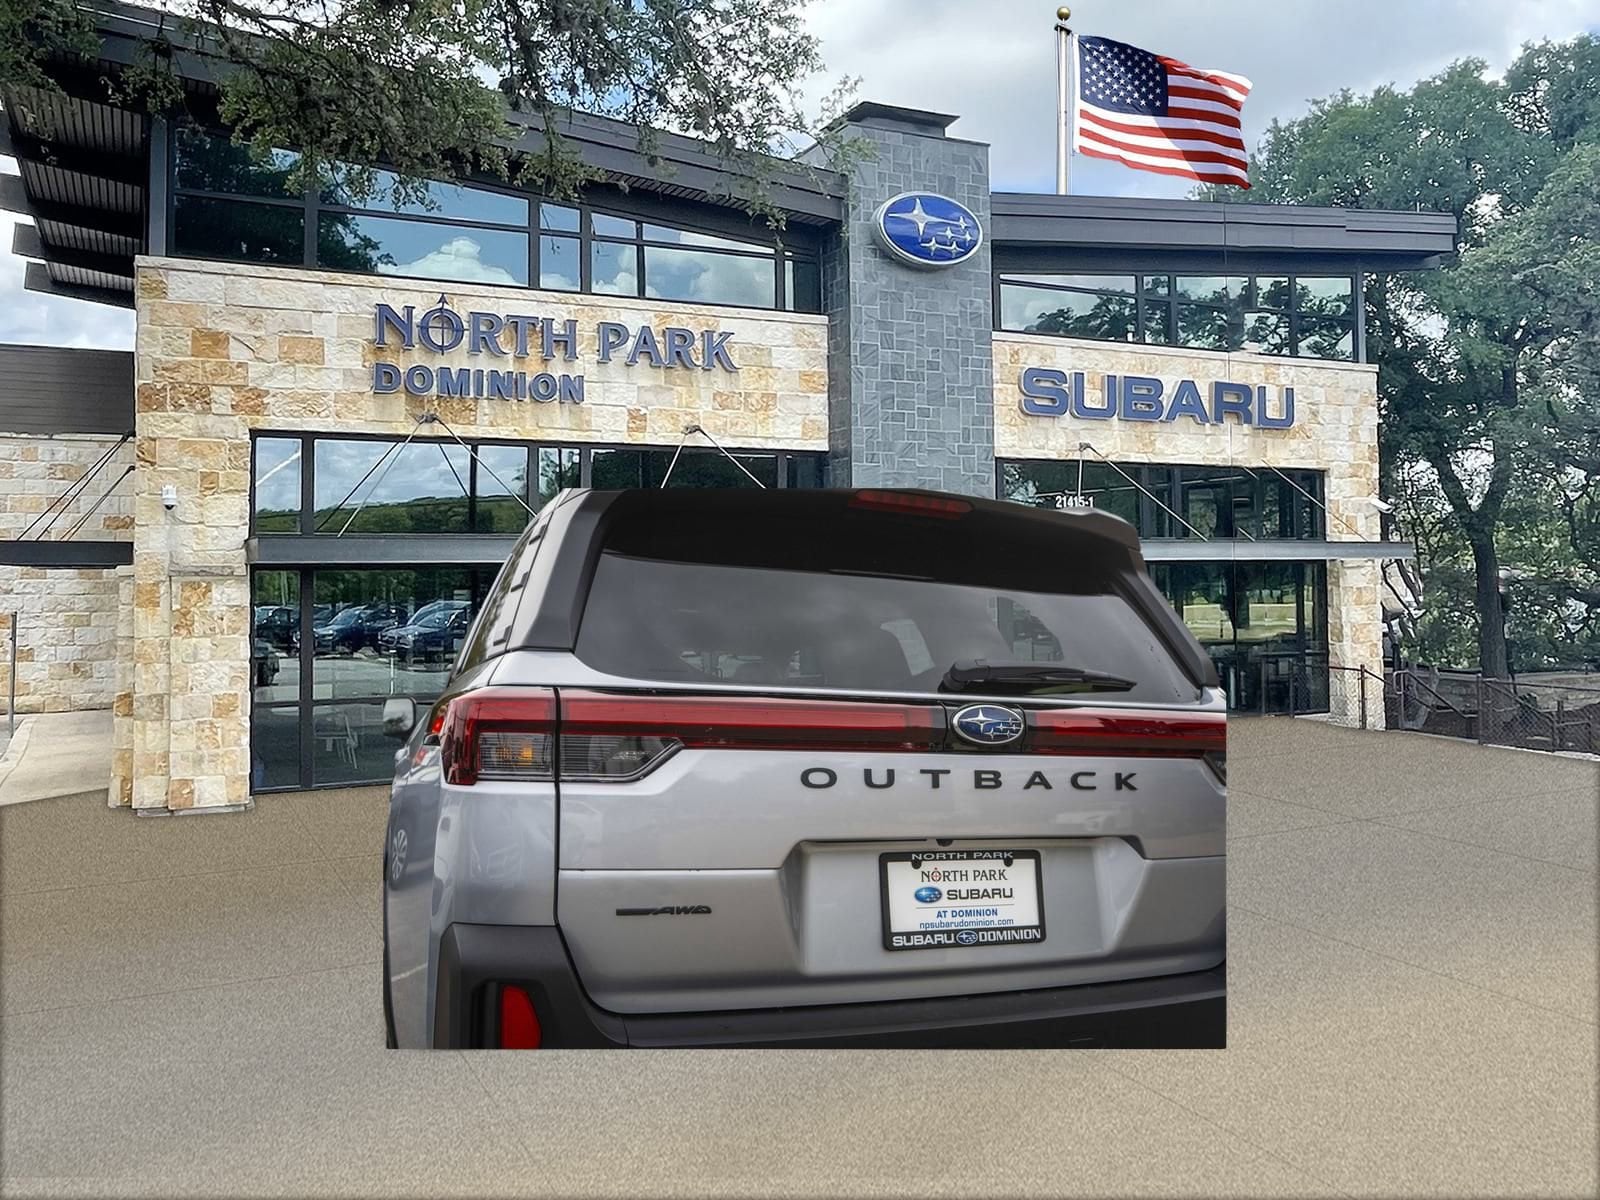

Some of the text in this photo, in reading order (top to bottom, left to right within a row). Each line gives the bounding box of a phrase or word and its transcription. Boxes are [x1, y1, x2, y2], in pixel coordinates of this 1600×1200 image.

[375, 294, 741, 373] NORTH PARK
[373, 363, 585, 404] DOMINION
[1019, 367, 1294, 429] SUBARU
[800, 767, 1138, 791] OUTBACK
[911, 851, 1014, 861] NORTH PARK
[921, 868, 1008, 882] NORTH PARK
[946, 888, 1013, 900] SUBARU
[654, 905, 712, 915] AWD
[936, 908, 998, 919] AT DOMINION
[919, 918, 1014, 930] npsubarudominion.com
[892, 928, 1041, 947] SUBARU DOMINION
